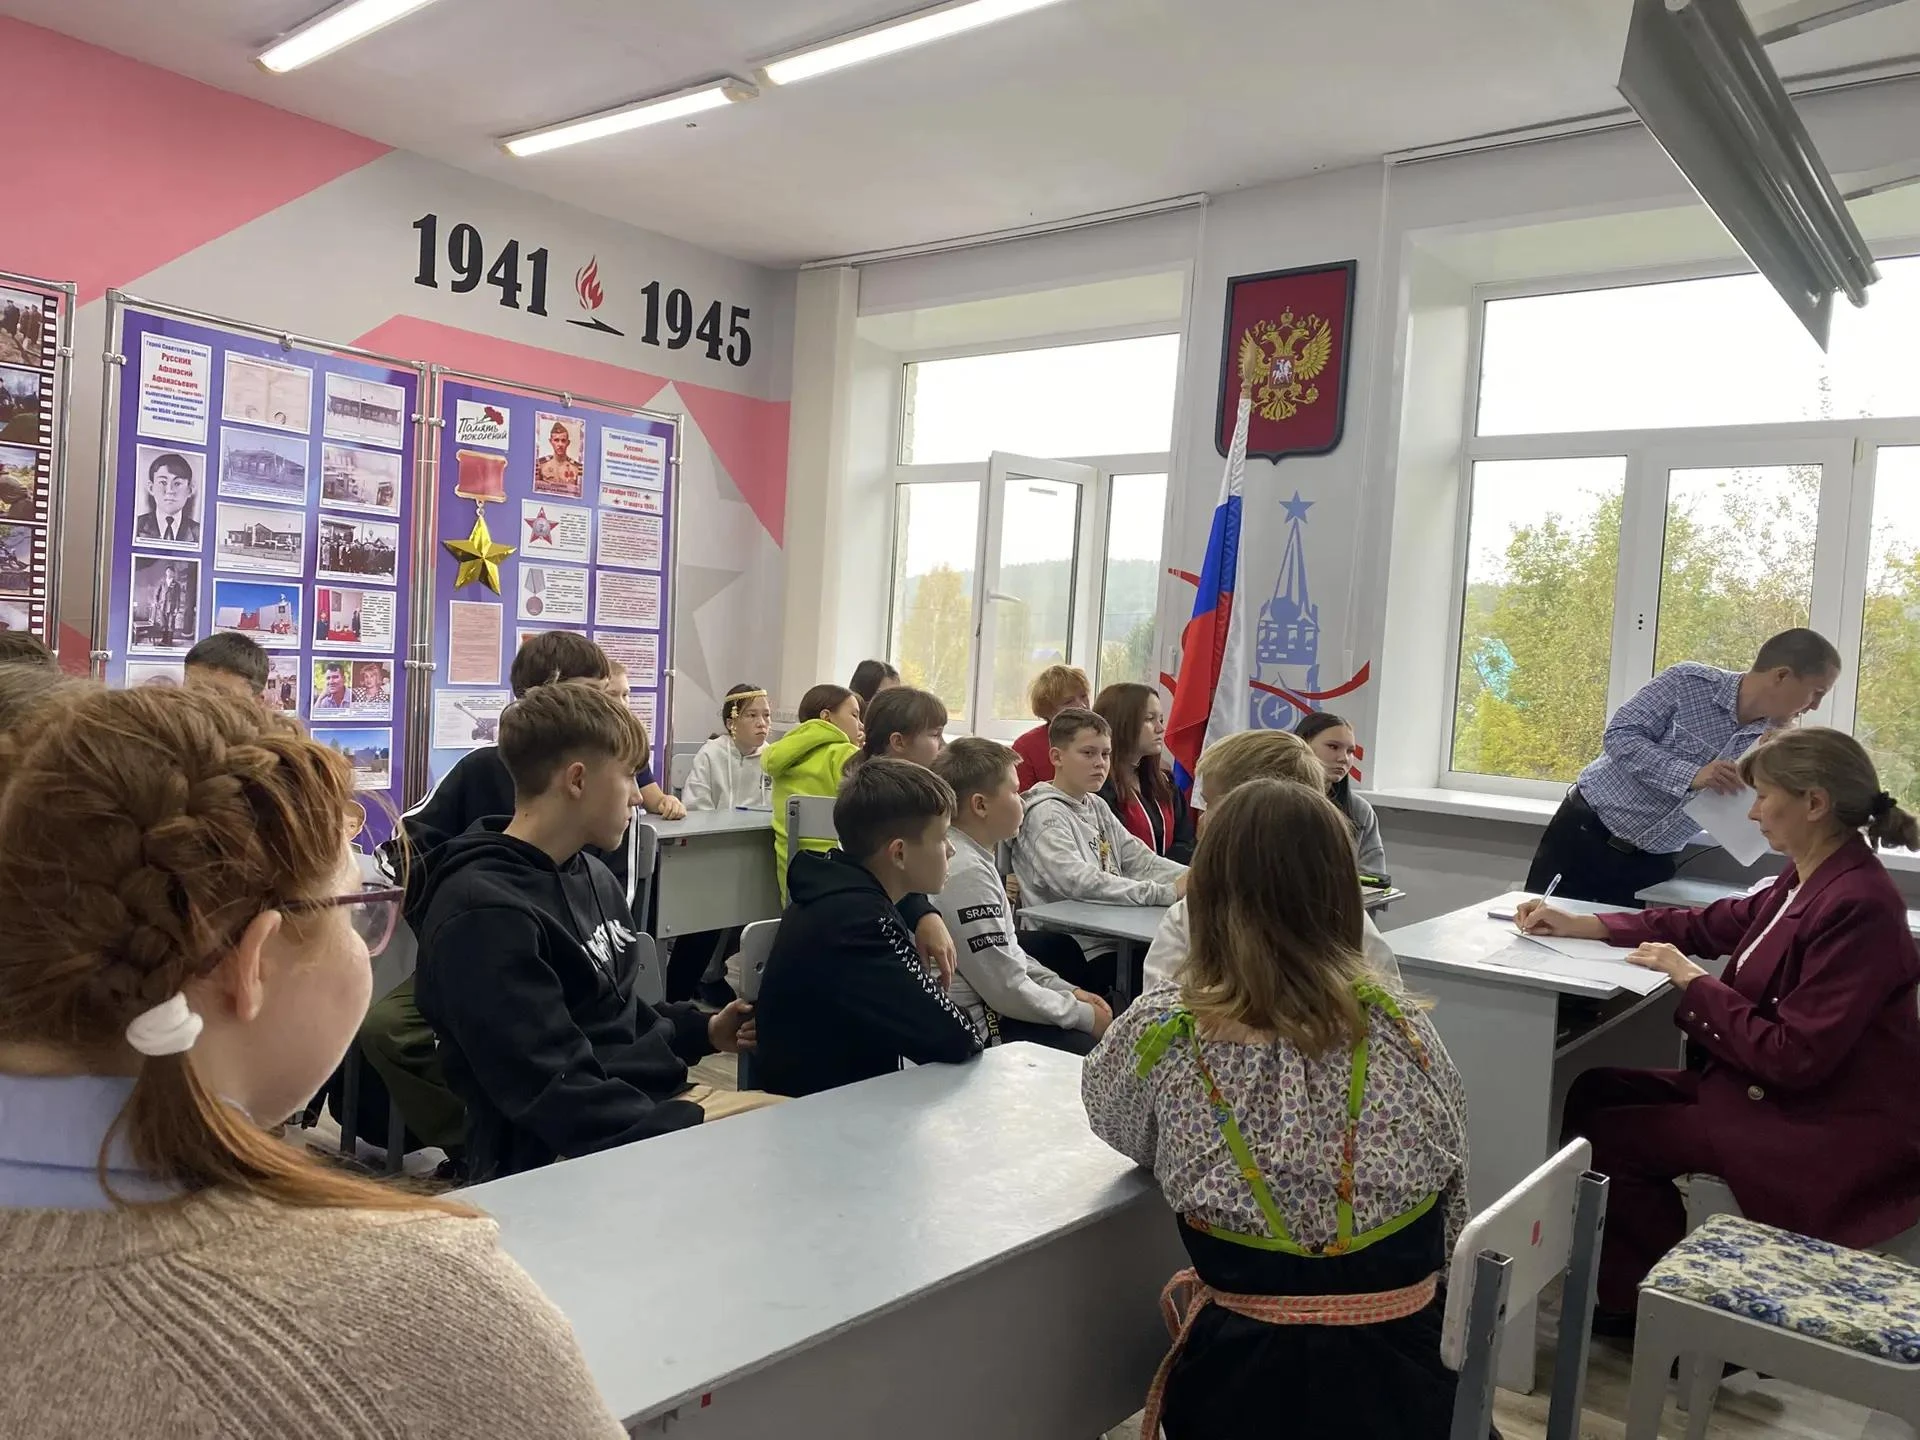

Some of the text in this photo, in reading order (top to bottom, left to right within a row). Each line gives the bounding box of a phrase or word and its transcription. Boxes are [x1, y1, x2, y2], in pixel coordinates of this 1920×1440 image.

[413, 213, 549, 317] 1941
[641, 281, 751, 367] 1945
[161, 352, 191, 366] Русских
[158, 364, 193, 378] Афанасий
[152, 375, 198, 390] Афанасьевич
[458, 417, 499, 434] Память
[461, 431, 508, 441] поколений
